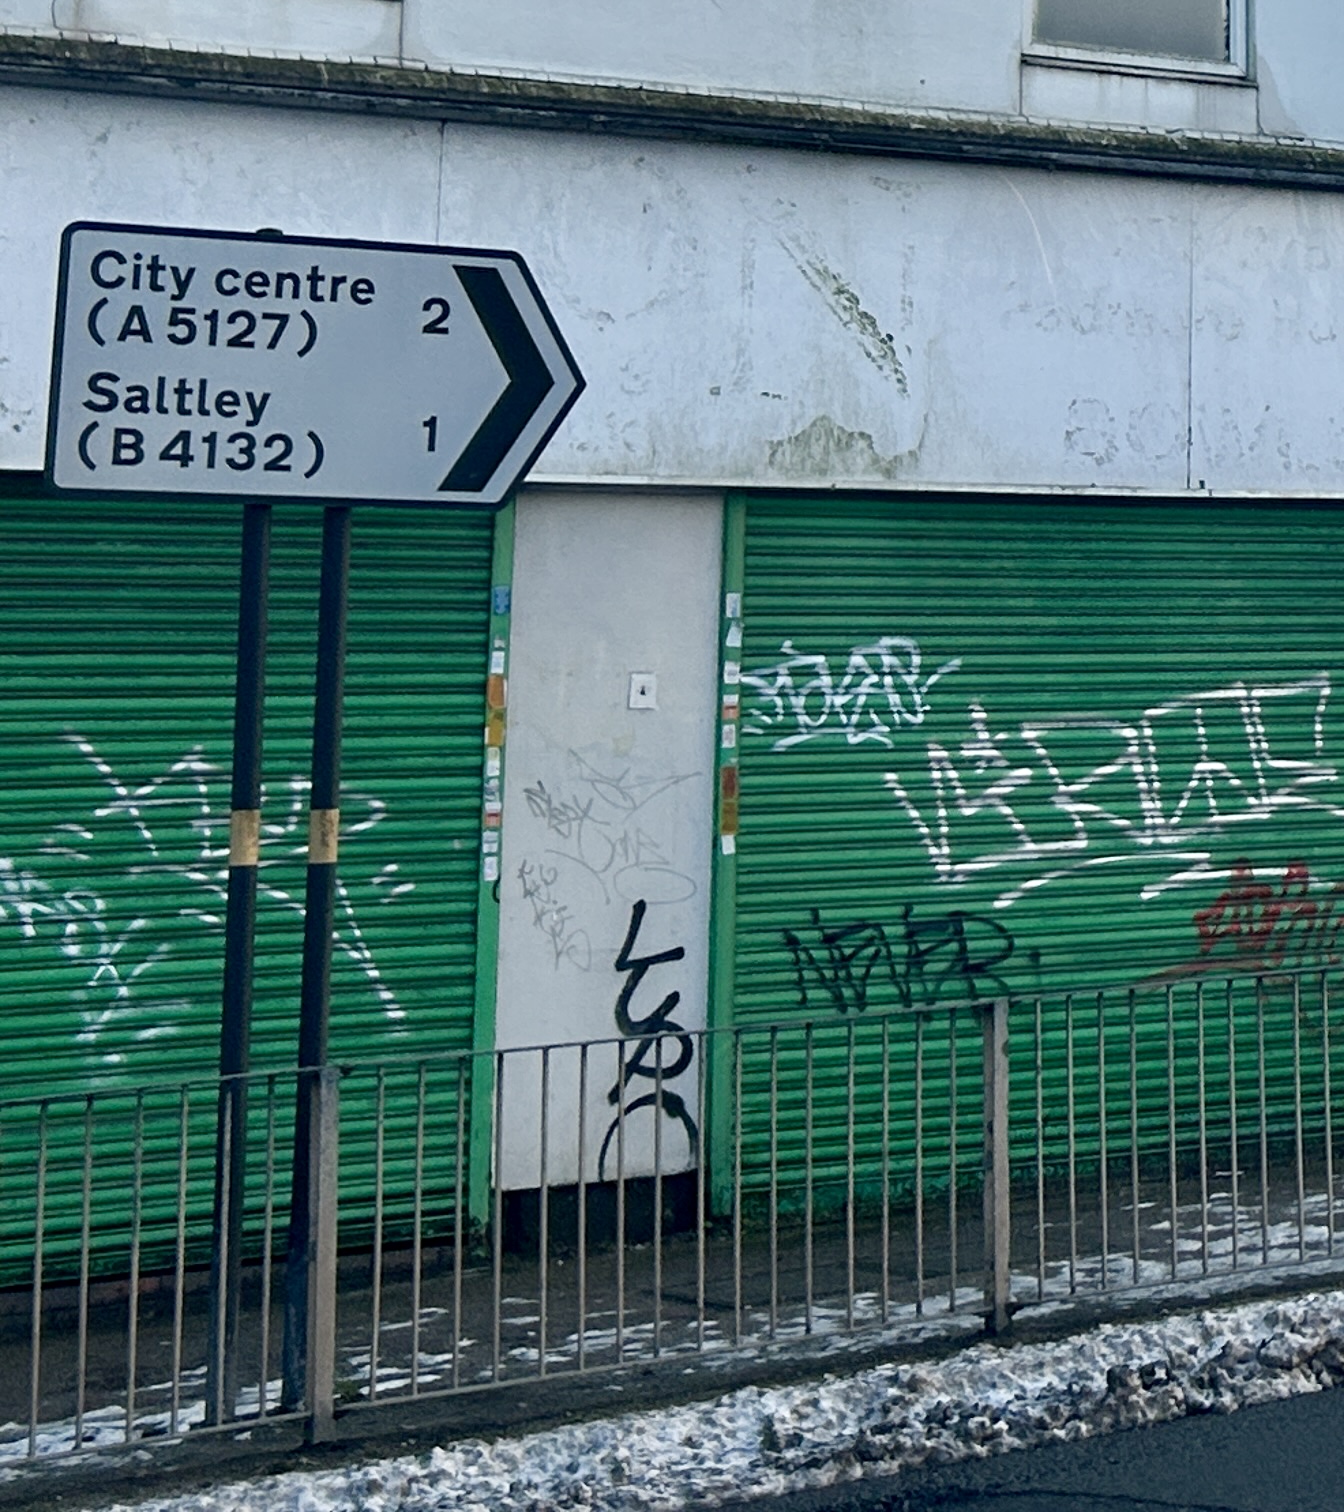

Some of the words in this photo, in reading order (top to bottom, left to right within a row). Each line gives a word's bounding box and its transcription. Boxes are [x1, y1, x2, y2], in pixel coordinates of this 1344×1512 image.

[90, 250, 196, 302] City
[214, 265, 376, 305] centre
[421, 297, 450, 335] 2
[82, 372, 270, 425] Saltley
[422, 415, 438, 452] 1
